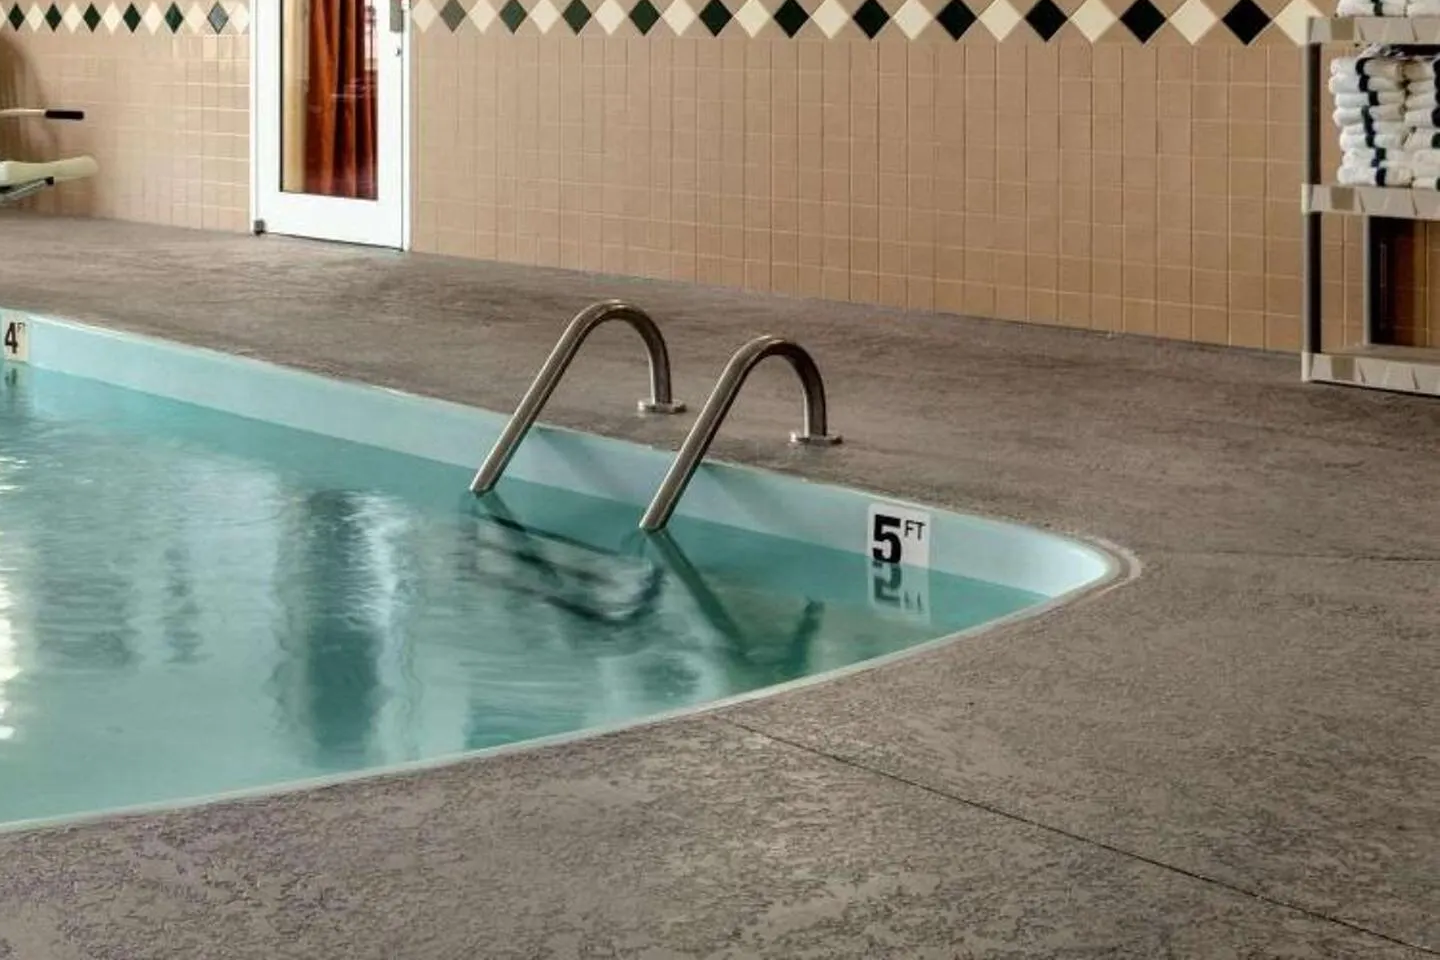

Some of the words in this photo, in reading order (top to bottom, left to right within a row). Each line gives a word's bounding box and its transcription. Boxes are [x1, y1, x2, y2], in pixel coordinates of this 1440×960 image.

[4, 321, 18, 354] 4
[872, 513, 902, 564] 5
[903, 519, 927, 541] FT
